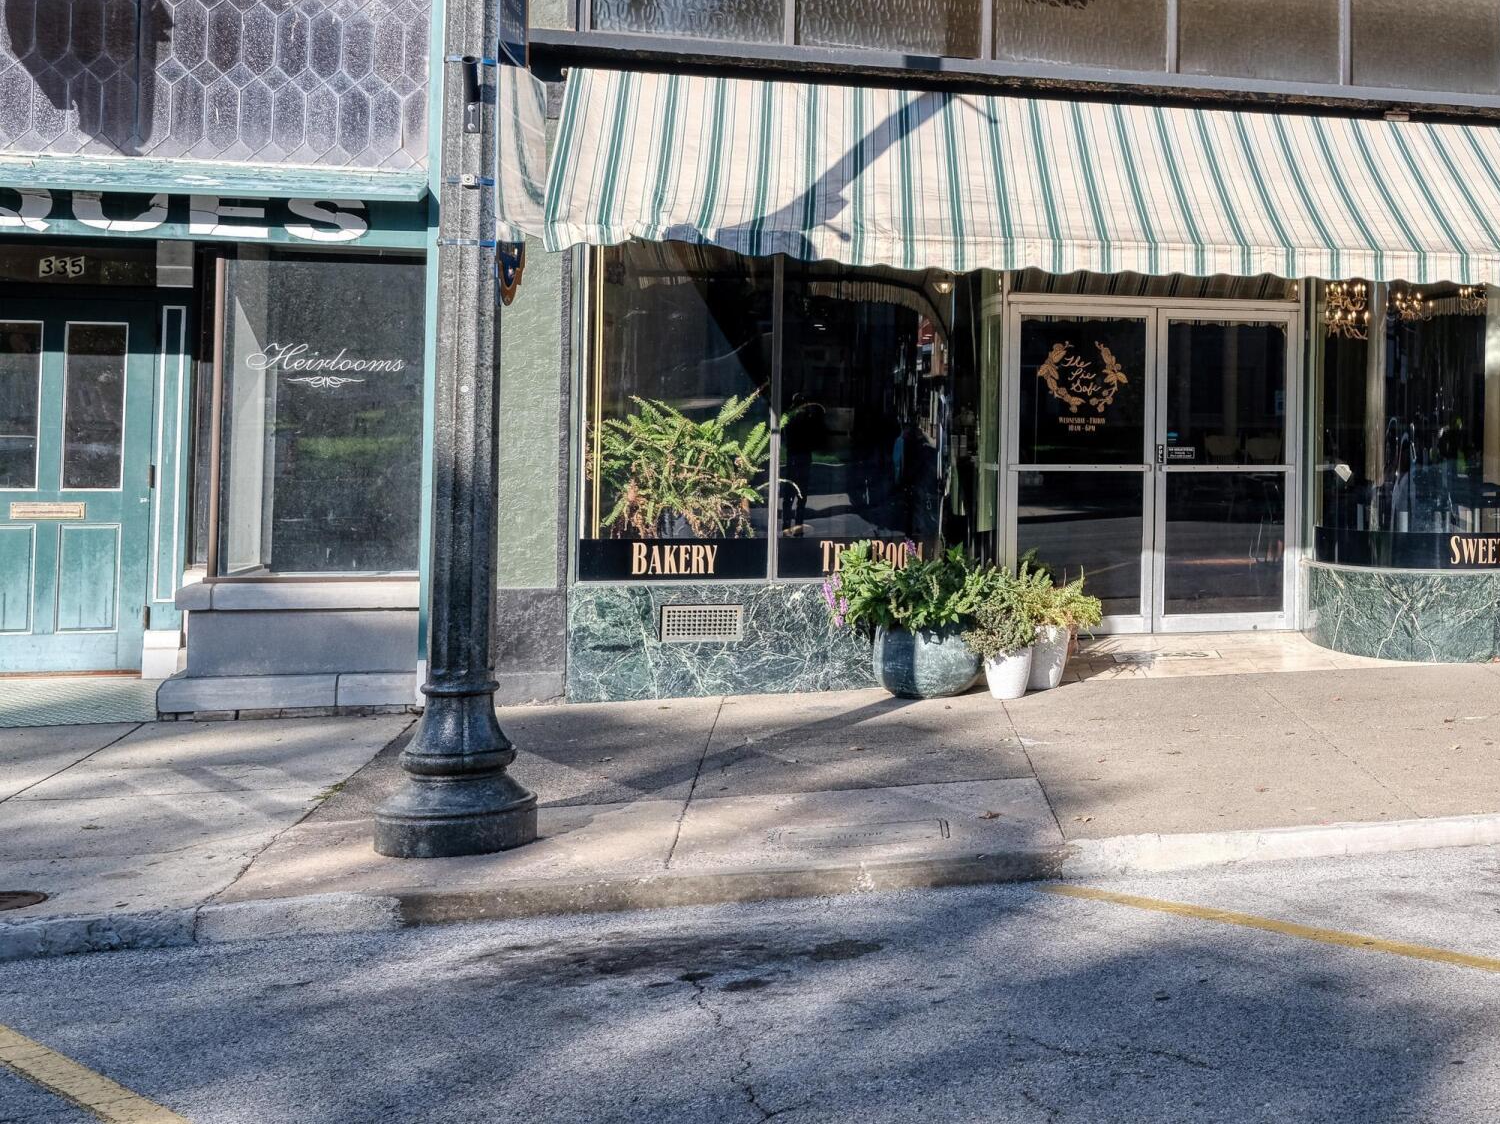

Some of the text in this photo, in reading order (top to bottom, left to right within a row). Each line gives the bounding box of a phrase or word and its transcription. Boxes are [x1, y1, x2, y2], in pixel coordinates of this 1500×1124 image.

[42, 259, 83, 275] 335
[246, 343, 404, 372] Heirlooms
[1061, 356, 1092, 367] The
[1068, 368, 1096, 380] Pie
[1071, 379, 1101, 396] Safe
[631, 542, 717, 574] BAKERY
[820, 540, 858, 572] TE
